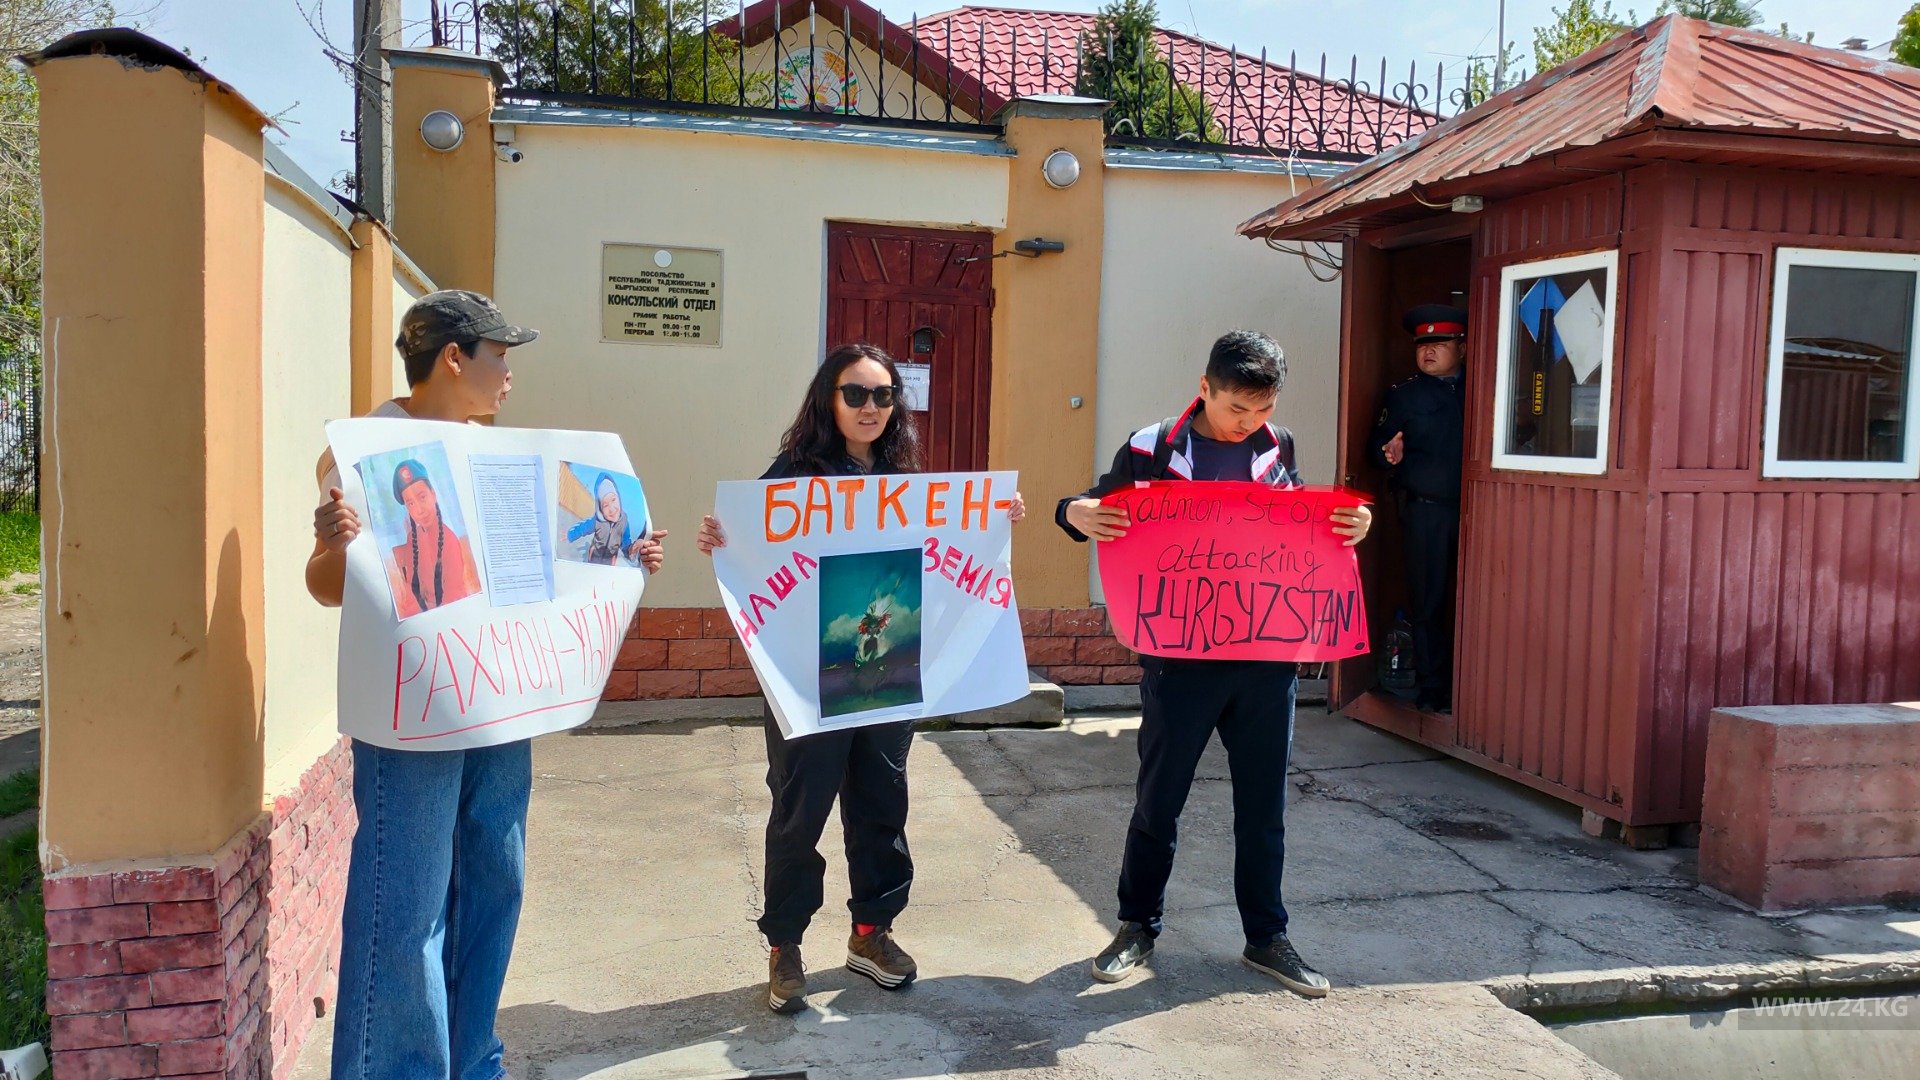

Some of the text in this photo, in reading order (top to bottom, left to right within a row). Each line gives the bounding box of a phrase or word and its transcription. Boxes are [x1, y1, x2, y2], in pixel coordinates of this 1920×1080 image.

[641, 271, 685, 279] ПОСОЛЬСТВО
[608, 276, 652, 285] РЕСПУБЛИКИ
[657, 279, 706, 287] ТАДЖИКИСТАН
[668, 287, 710, 295] РЕСПУБЛИКЕ
[608, 294, 716, 312] КОНСУЛЬСКИЙ ОТДЕЛ
[633, 312, 658, 320] ГРАФИК
[624, 328, 655, 336] ПЕРЕРЫВ
[1157, 537, 1325, 592] attacking
[735, 536, 1012, 649] НАША ЗЕМЛЯ
[1132, 566, 1366, 654] KYRGYZSTAN!
